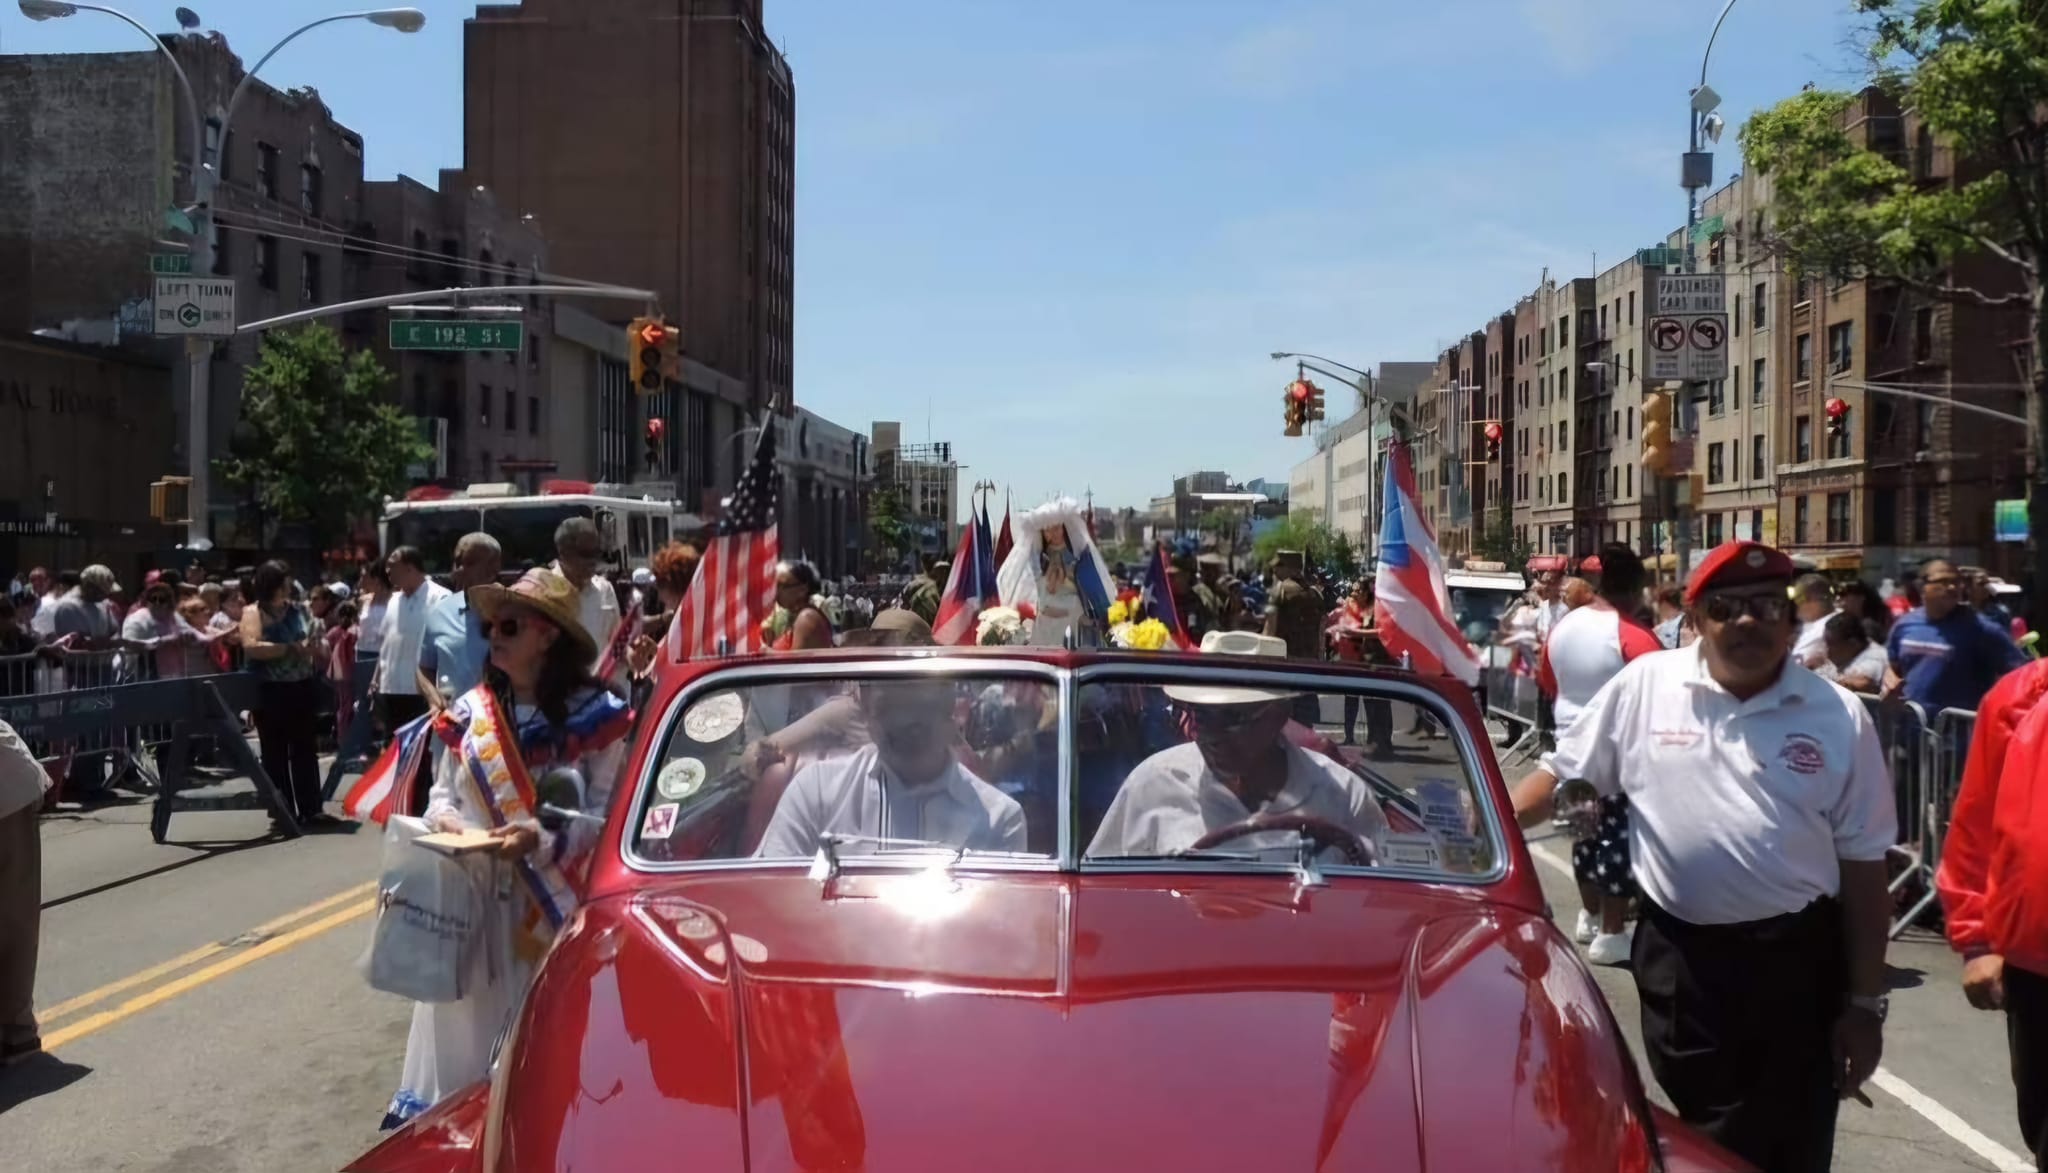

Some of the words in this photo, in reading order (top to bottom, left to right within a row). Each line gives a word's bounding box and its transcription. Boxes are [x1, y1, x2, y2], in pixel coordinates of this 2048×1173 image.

[159, 281, 189, 296] LEFT
[198, 284, 233, 297] TURN
[434, 327, 468, 344] 192
